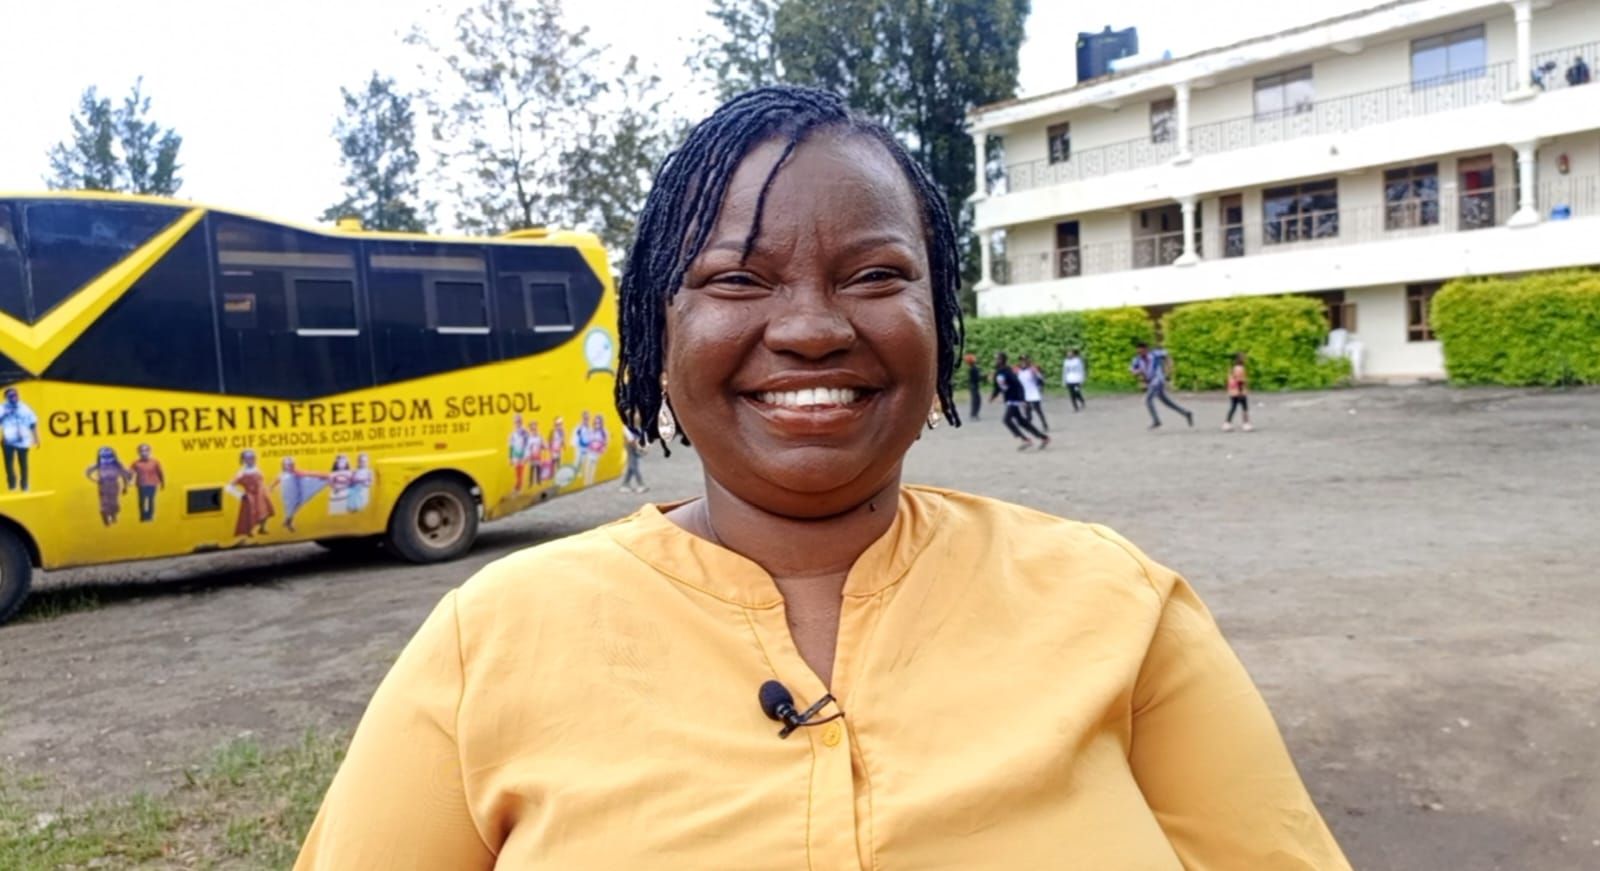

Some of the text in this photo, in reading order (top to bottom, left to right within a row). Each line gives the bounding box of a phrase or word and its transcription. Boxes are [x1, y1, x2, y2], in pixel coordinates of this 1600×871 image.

[48, 392, 541, 438] CHILDREN IN FREEDOM SCHOOL
[367, 427, 386, 441] OR
